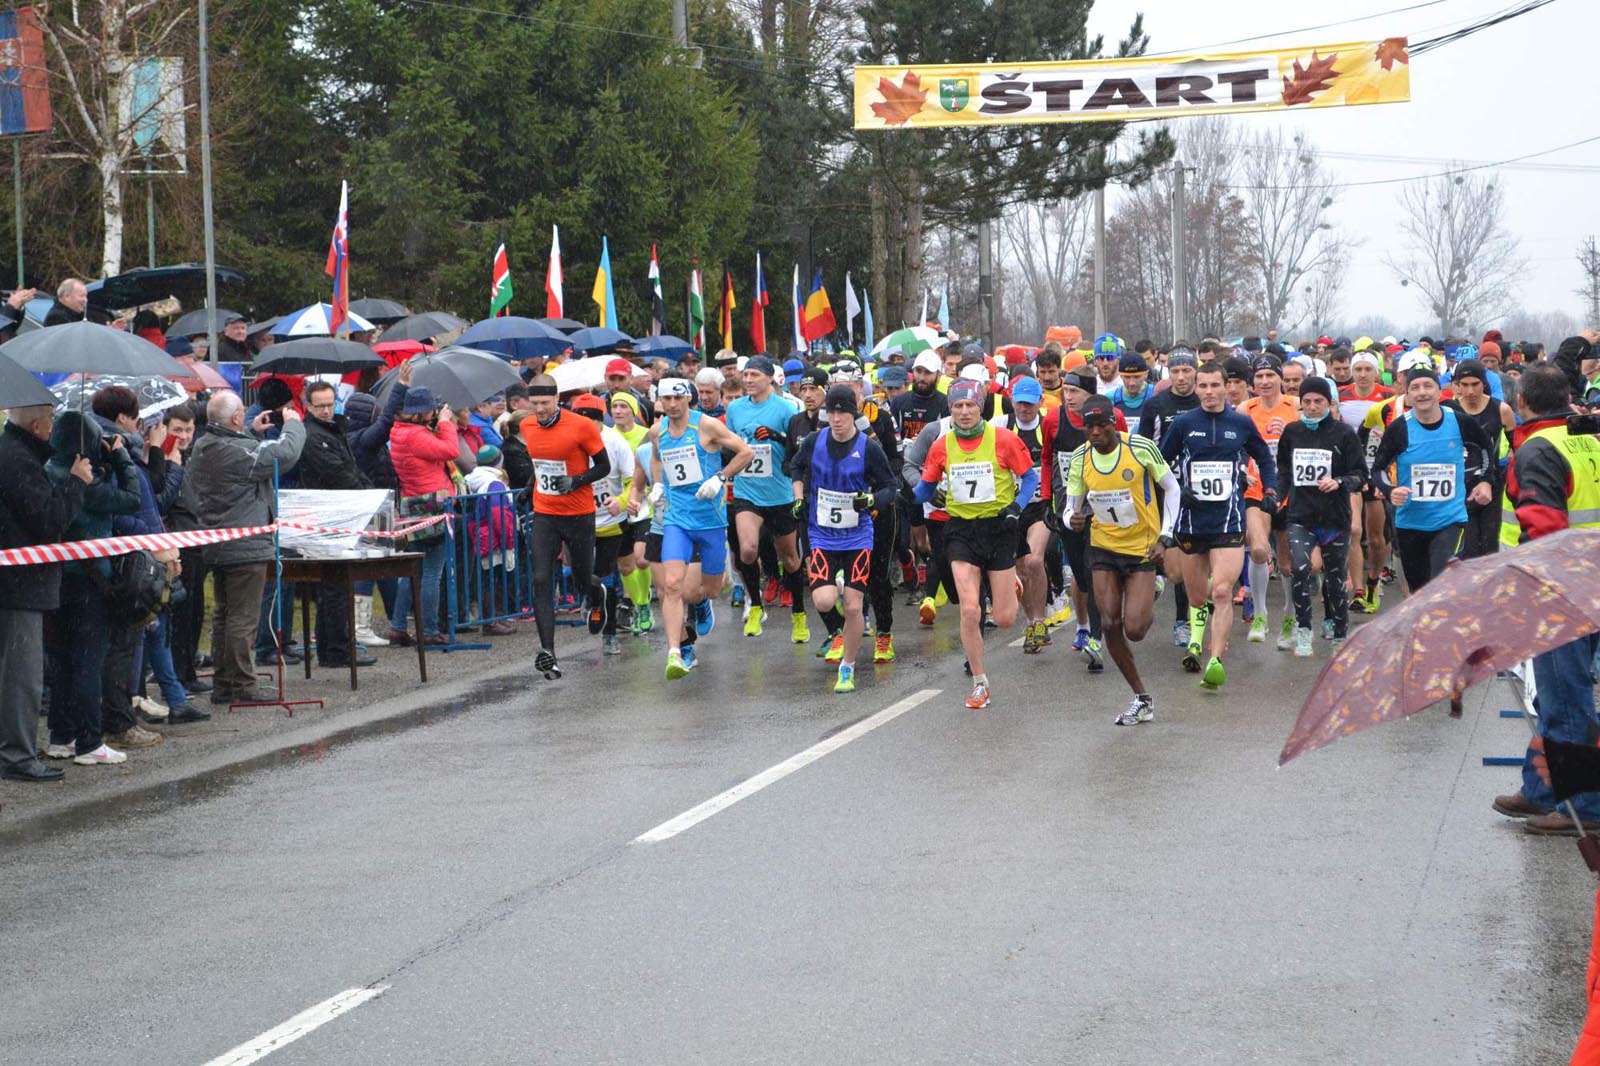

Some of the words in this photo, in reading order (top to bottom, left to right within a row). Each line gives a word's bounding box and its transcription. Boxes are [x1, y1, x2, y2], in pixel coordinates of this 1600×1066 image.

[978, 69, 1269, 114] ŠTART
[674, 463, 687, 481] 3
[1296, 464, 1328, 482] 292
[965, 480, 978, 498] 7
[1200, 478, 1224, 496] 90
[1415, 479, 1452, 497] 170
[830, 507, 842, 524] 5
[1106, 506, 1119, 523] 1
